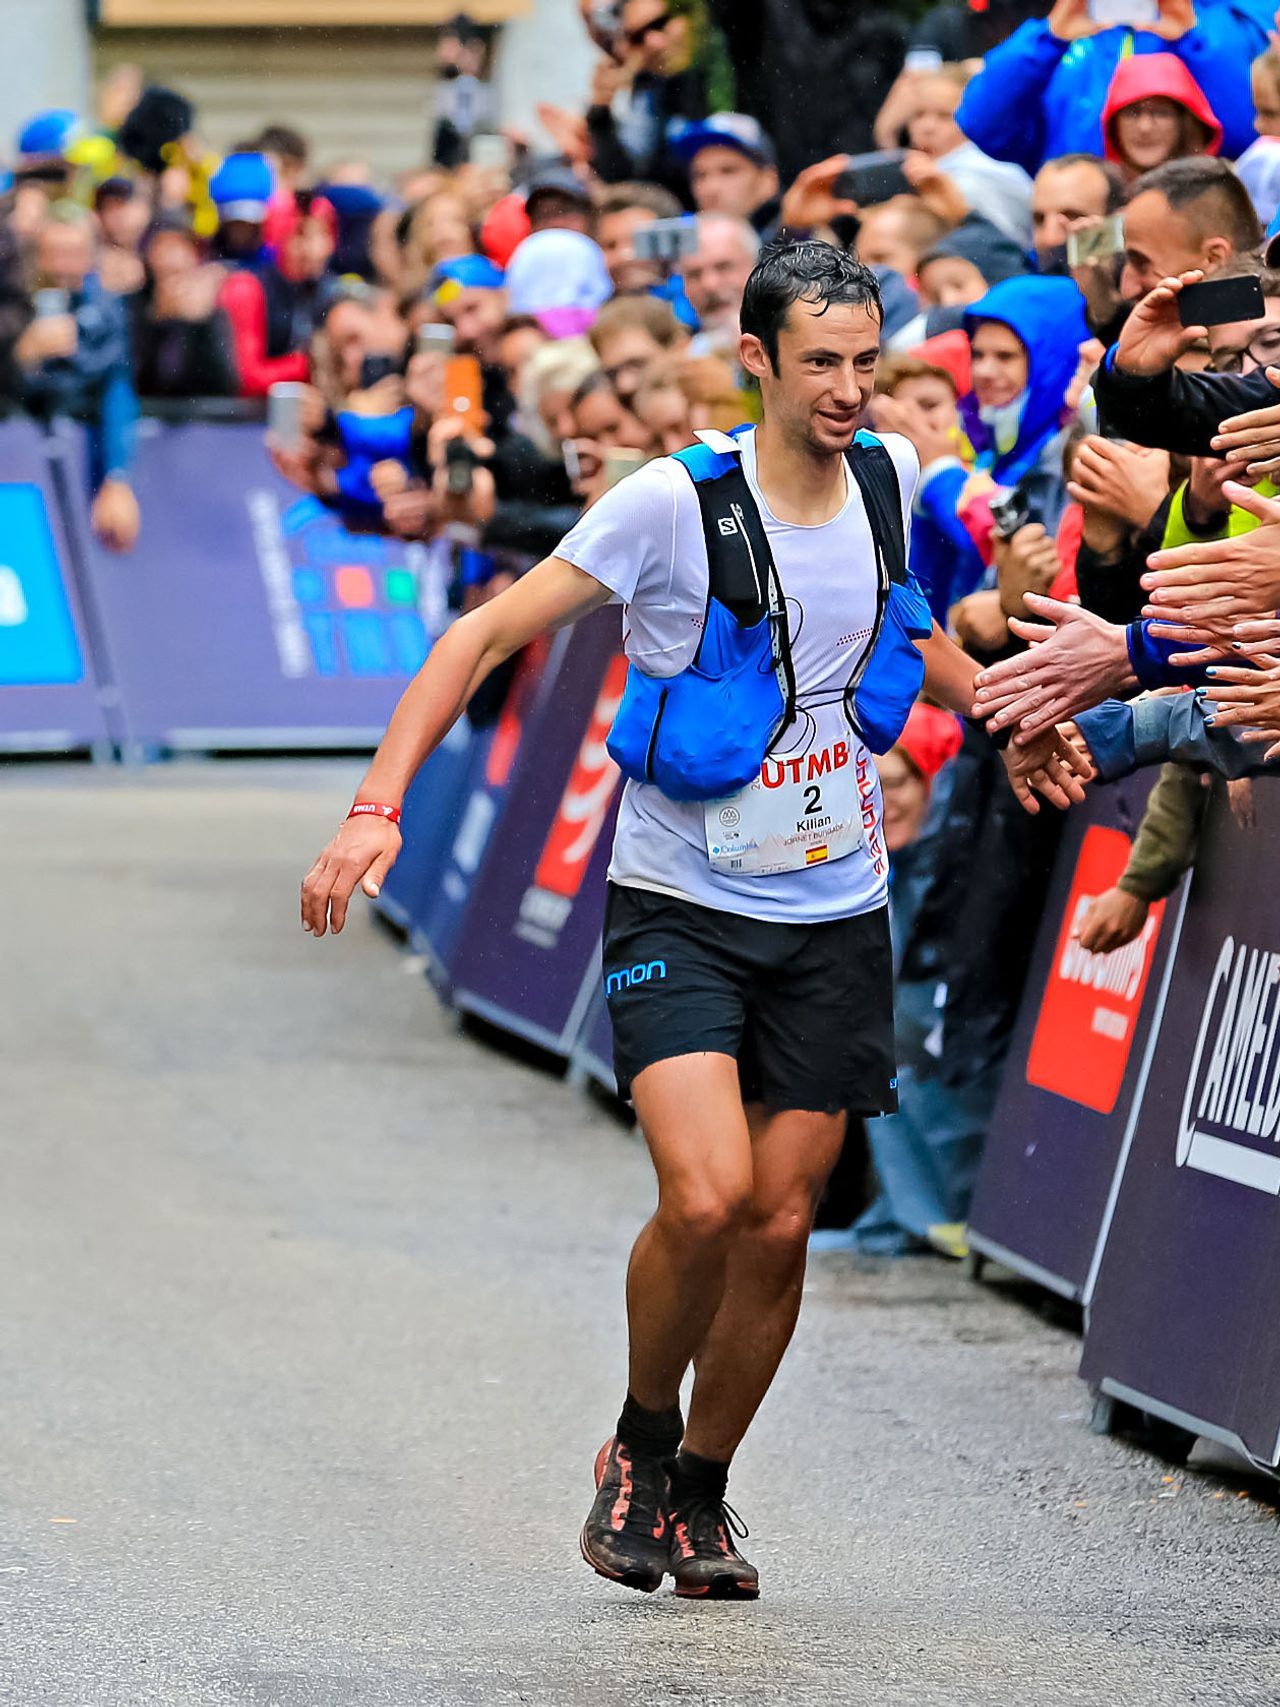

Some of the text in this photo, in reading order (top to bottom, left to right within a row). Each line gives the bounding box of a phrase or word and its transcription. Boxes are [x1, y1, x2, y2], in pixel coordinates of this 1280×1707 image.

[761, 741, 848, 788] UTMB
[803, 785, 822, 815] 2
[796, 815, 831, 833] Kilian
